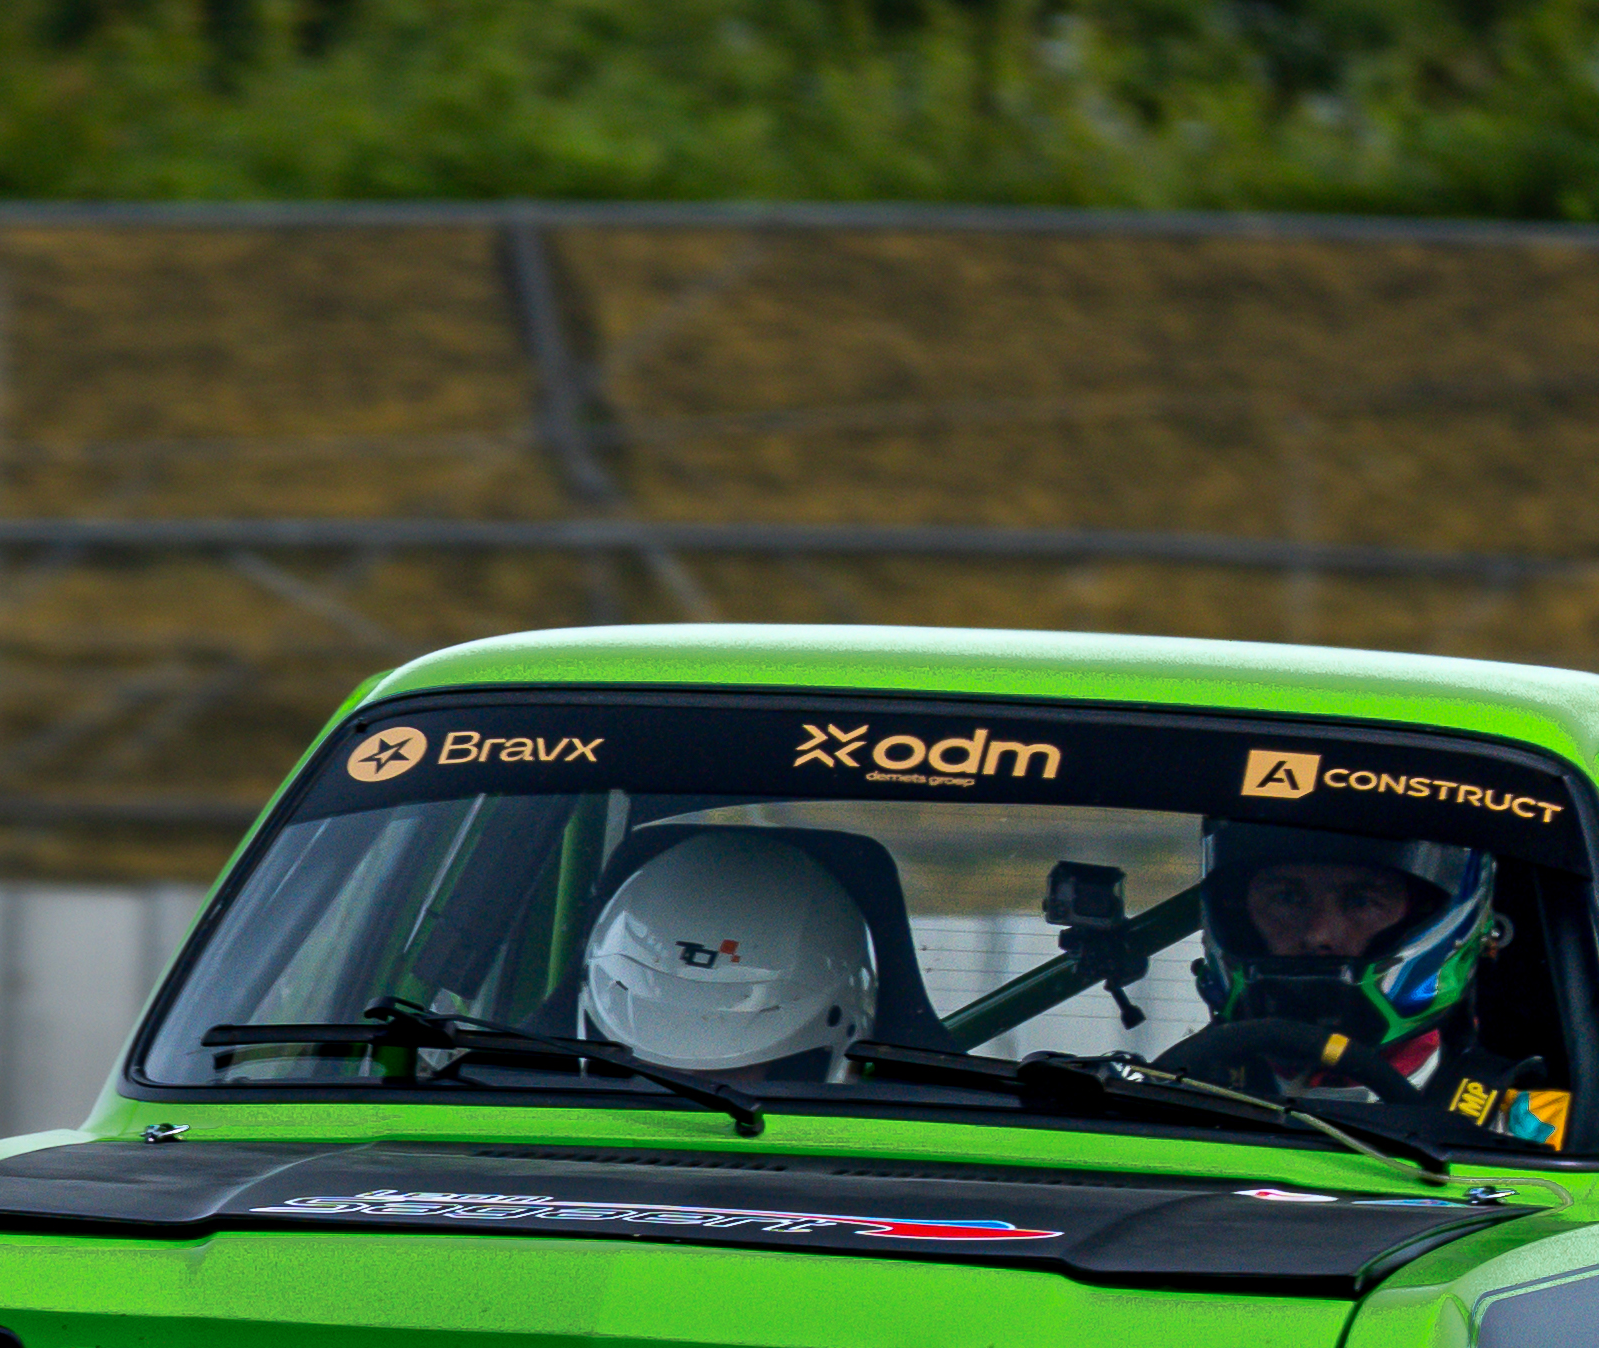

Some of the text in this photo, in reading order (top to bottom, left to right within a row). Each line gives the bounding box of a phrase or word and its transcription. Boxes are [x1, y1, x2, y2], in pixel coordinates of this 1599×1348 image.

[437, 730, 605, 765] Bravx
[872, 729, 1062, 780] odm
[1322, 767, 1565, 825] CONSTRUCT
